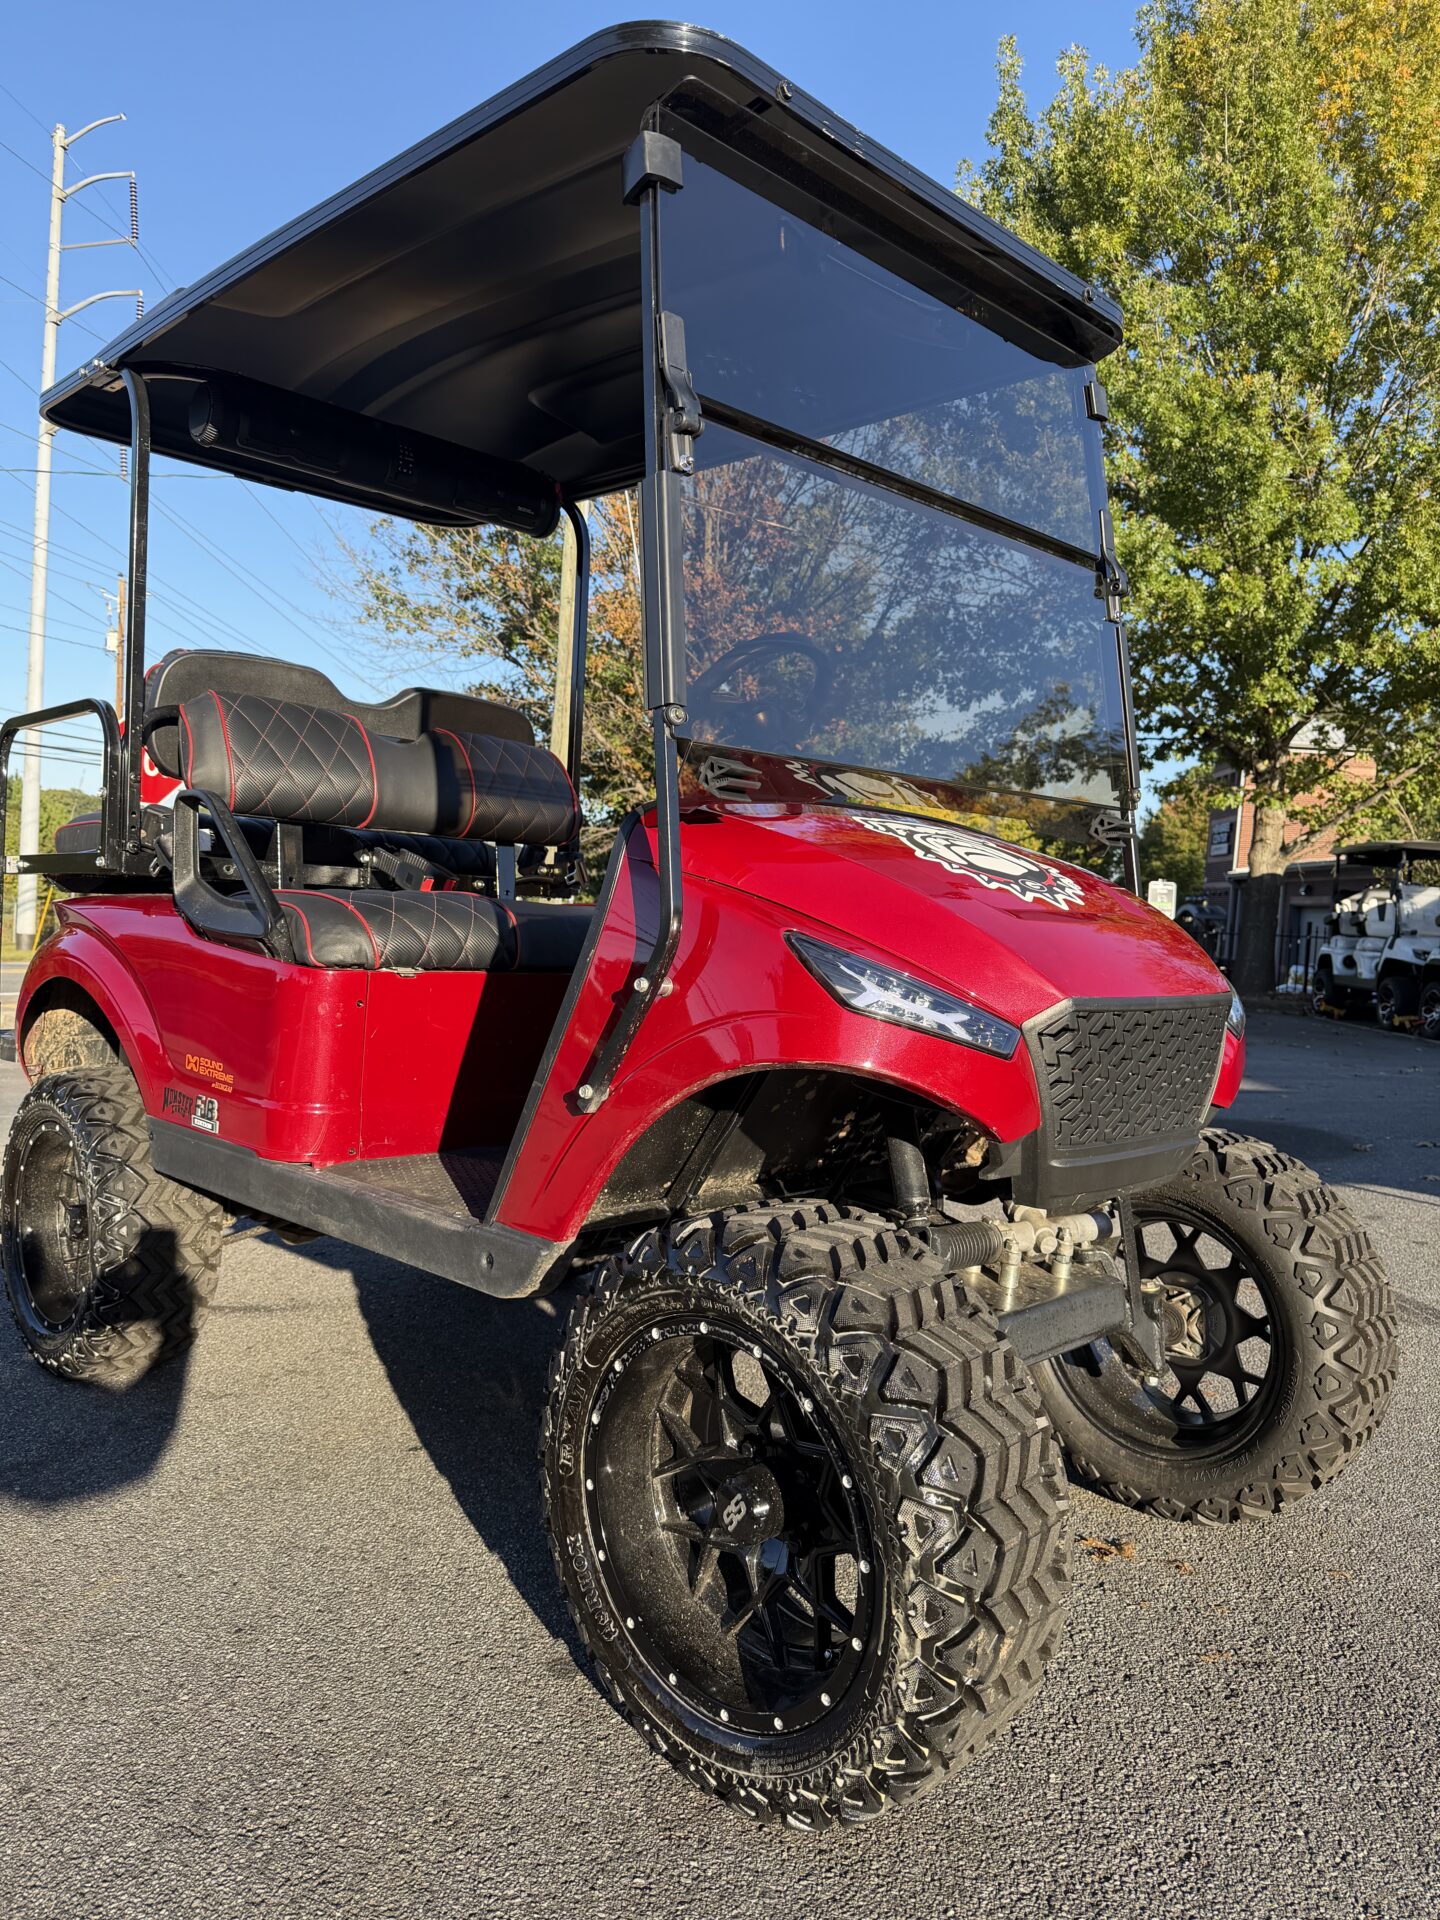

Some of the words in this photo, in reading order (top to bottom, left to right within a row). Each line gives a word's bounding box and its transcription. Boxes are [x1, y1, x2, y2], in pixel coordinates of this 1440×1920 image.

[200, 1057, 223, 1071] SOUND
[199, 1066, 234, 1083] EXTREME
[162, 1087, 193, 1119] MONSTER
